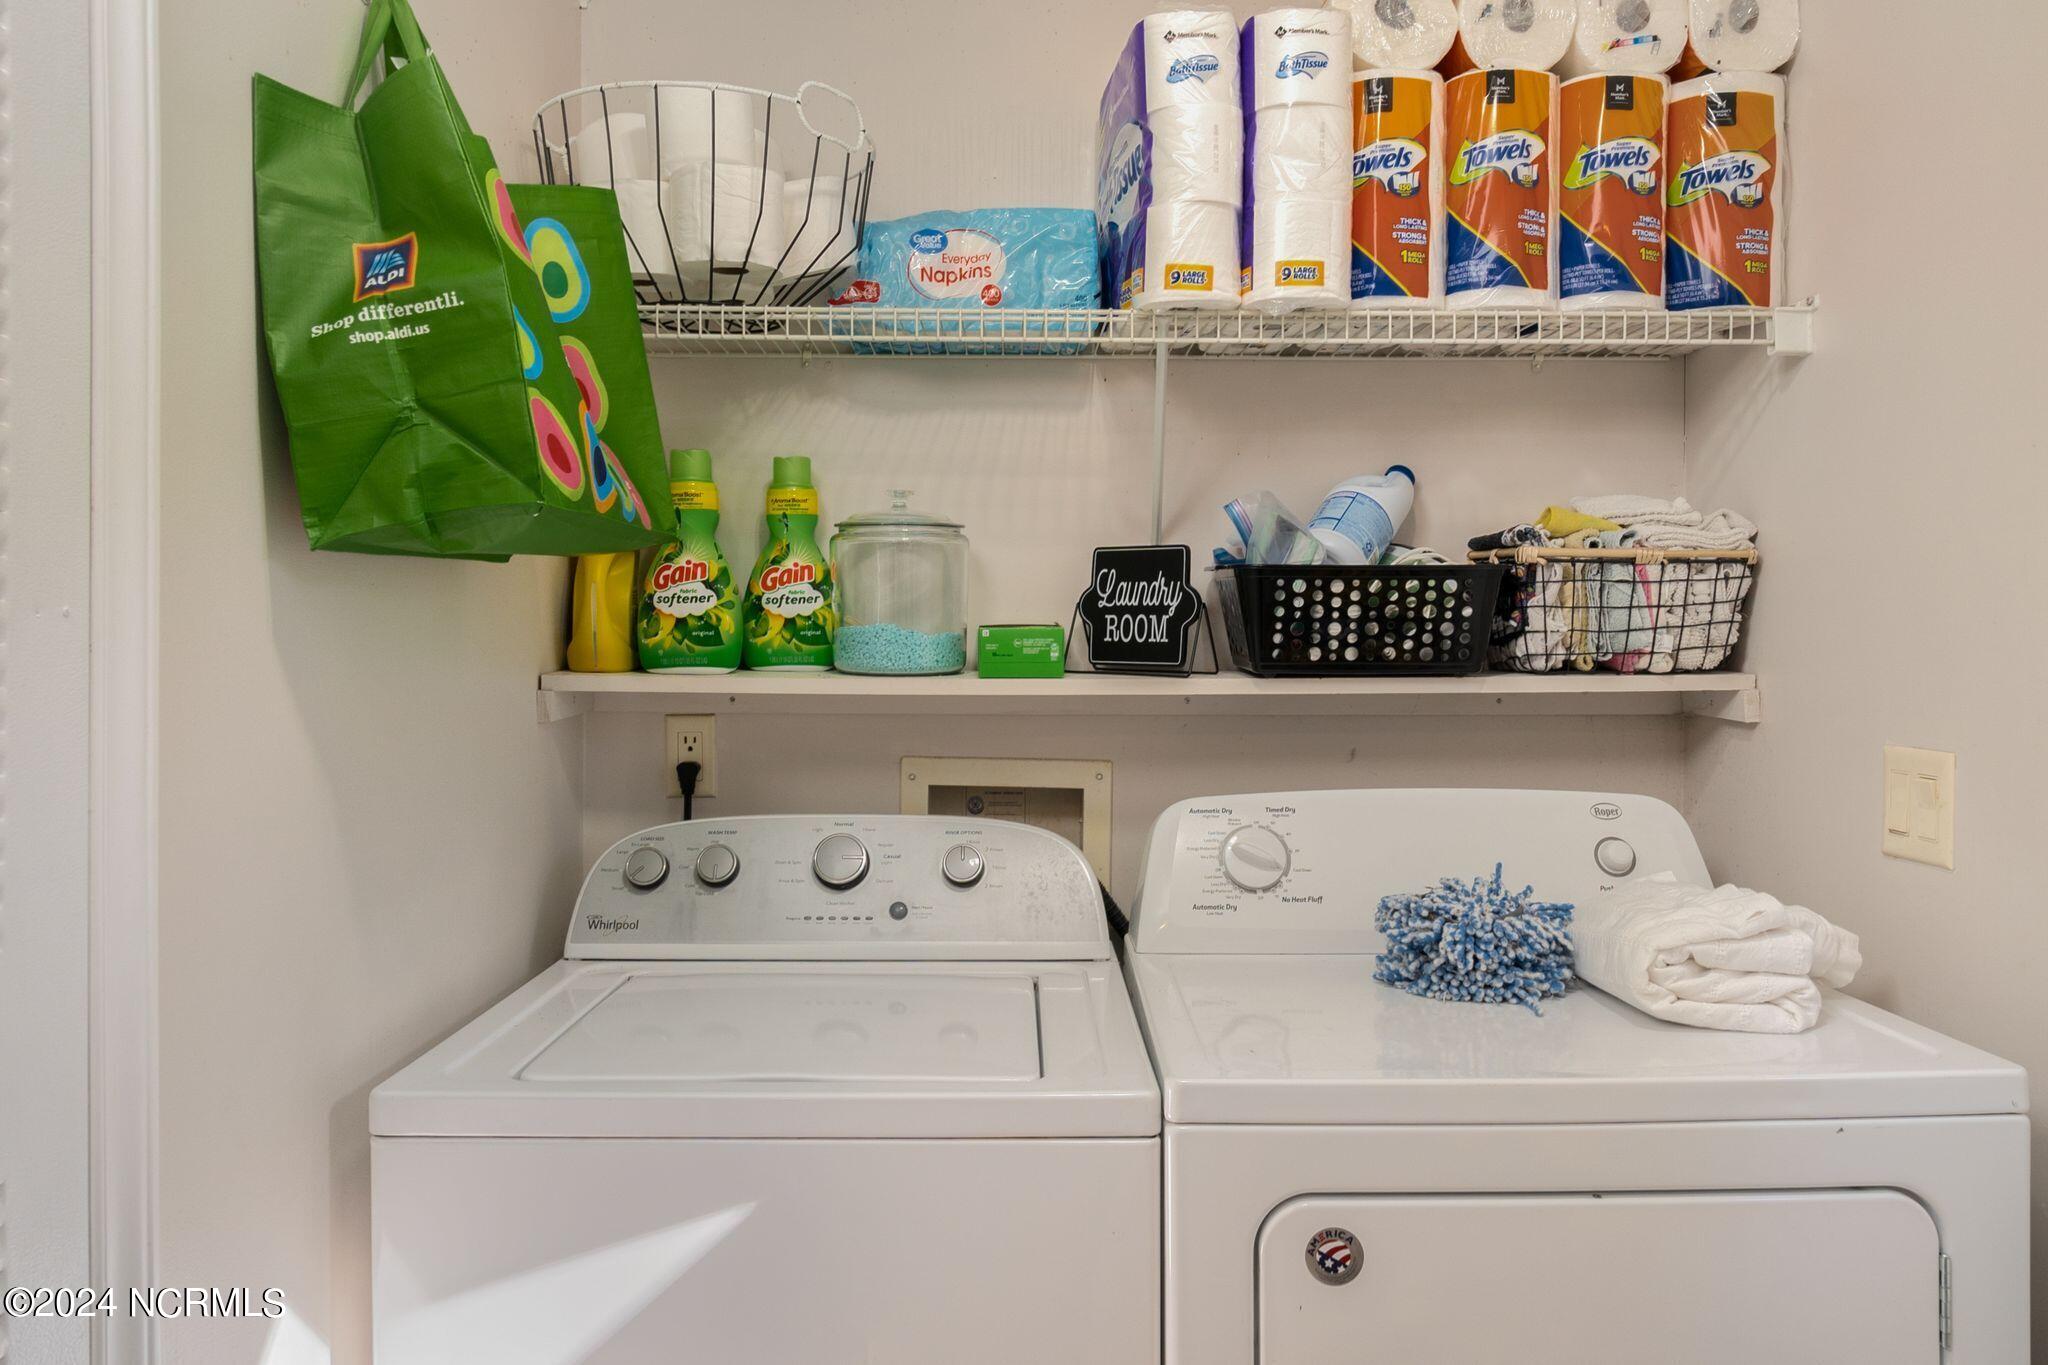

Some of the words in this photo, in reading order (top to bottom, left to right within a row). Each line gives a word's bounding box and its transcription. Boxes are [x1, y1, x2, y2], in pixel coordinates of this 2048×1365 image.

[1462, 138, 1532, 174] Towels
[1580, 145, 1650, 178] Towels
[1680, 160, 1755, 196] Towels
[1400, 217, 1420, 225] THICK
[1639, 215, 1657, 223] THICK
[913, 234, 943, 244] Great
[1392, 231, 1420, 240] STRONG
[1632, 228, 1656, 237] STRONG
[1524, 241, 1529, 253] 1
[1736, 242, 1763, 250] STRONG
[941, 252, 991, 266] Everyday
[1401, 250, 1407, 263] 1
[1640, 247, 1645, 260] 1
[1745, 260, 1751, 272] 1
[364, 267, 405, 288] ALDI
[920, 265, 992, 286] Napkins
[1171, 270, 1181, 284] 9
[1182, 271, 1206, 279] LARGE
[1281, 267, 1291, 281] 9
[1293, 266, 1317, 274] LARGE
[1293, 272, 1318, 280] ROLLS
[311, 314, 354, 338] Shop
[358, 291, 465, 322] differentli.
[349, 324, 430, 344] shop.aldi.us
[654, 559, 708, 590] Gain
[761, 561, 814, 592] Gain
[1096, 568, 1182, 616] Laundry
[656, 593, 714, 608] softener
[765, 594, 820, 608] softener
[692, 629, 715, 637] original
[800, 629, 821, 637] original
[1104, 614, 1169, 642] ROOM
[1594, 807, 1619, 817] Roper
[1307, 896, 1323, 904] Fluff
[1226, 904, 1238, 912] Dry
[588, 919, 639, 931] Whirlpool
[1308, 1230, 1353, 1257] AMERICA
